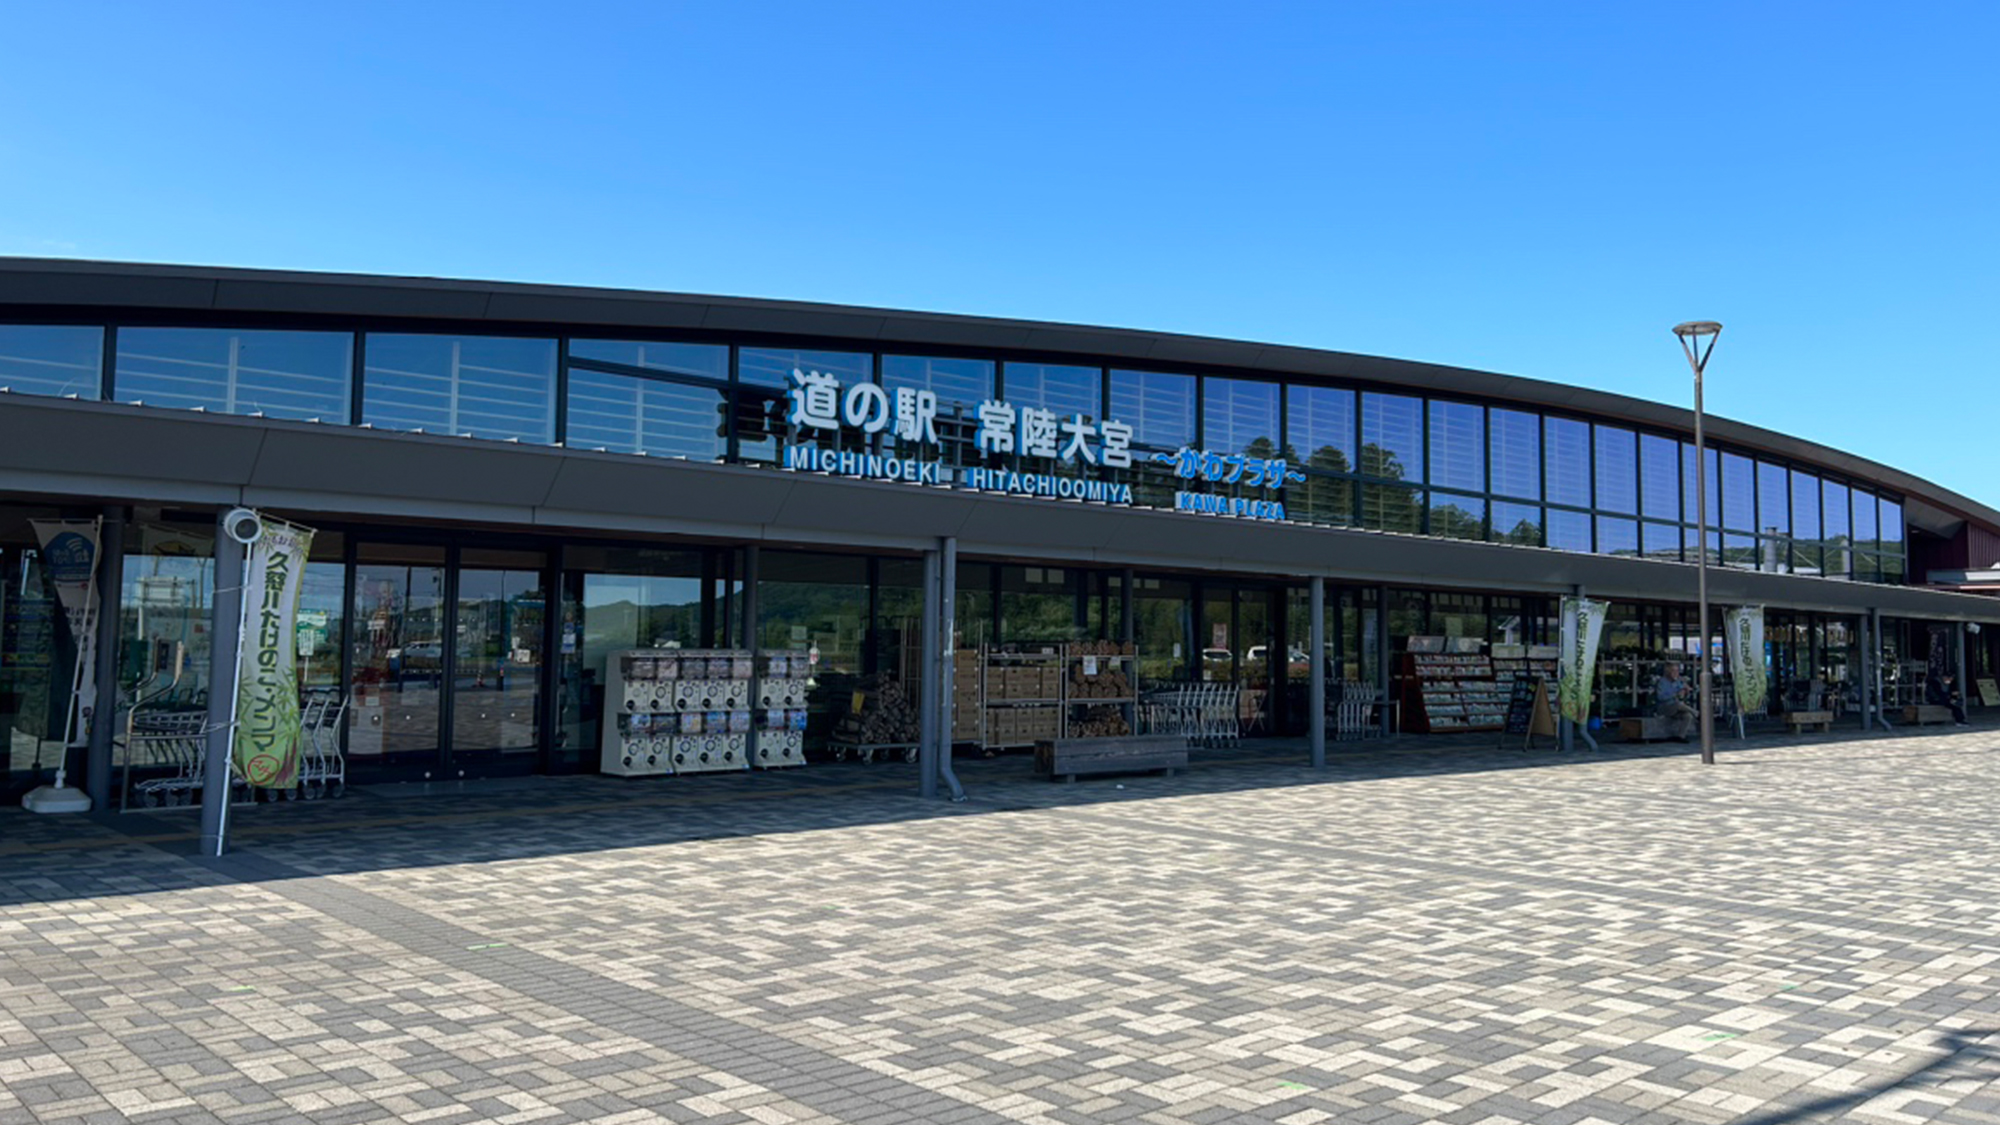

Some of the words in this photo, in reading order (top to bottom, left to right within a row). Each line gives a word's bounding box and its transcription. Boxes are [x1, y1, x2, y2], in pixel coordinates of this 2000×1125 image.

[788, 368, 937, 444] 道の駅
[975, 399, 1133, 469] 常陸大宮
[787, 445, 940, 484] MICHINOEKI
[969, 467, 1134, 504] HITACHIOOMIYA
[1176, 491, 1229, 514] KAWA
[1230, 498, 1286, 520] PLAZA
